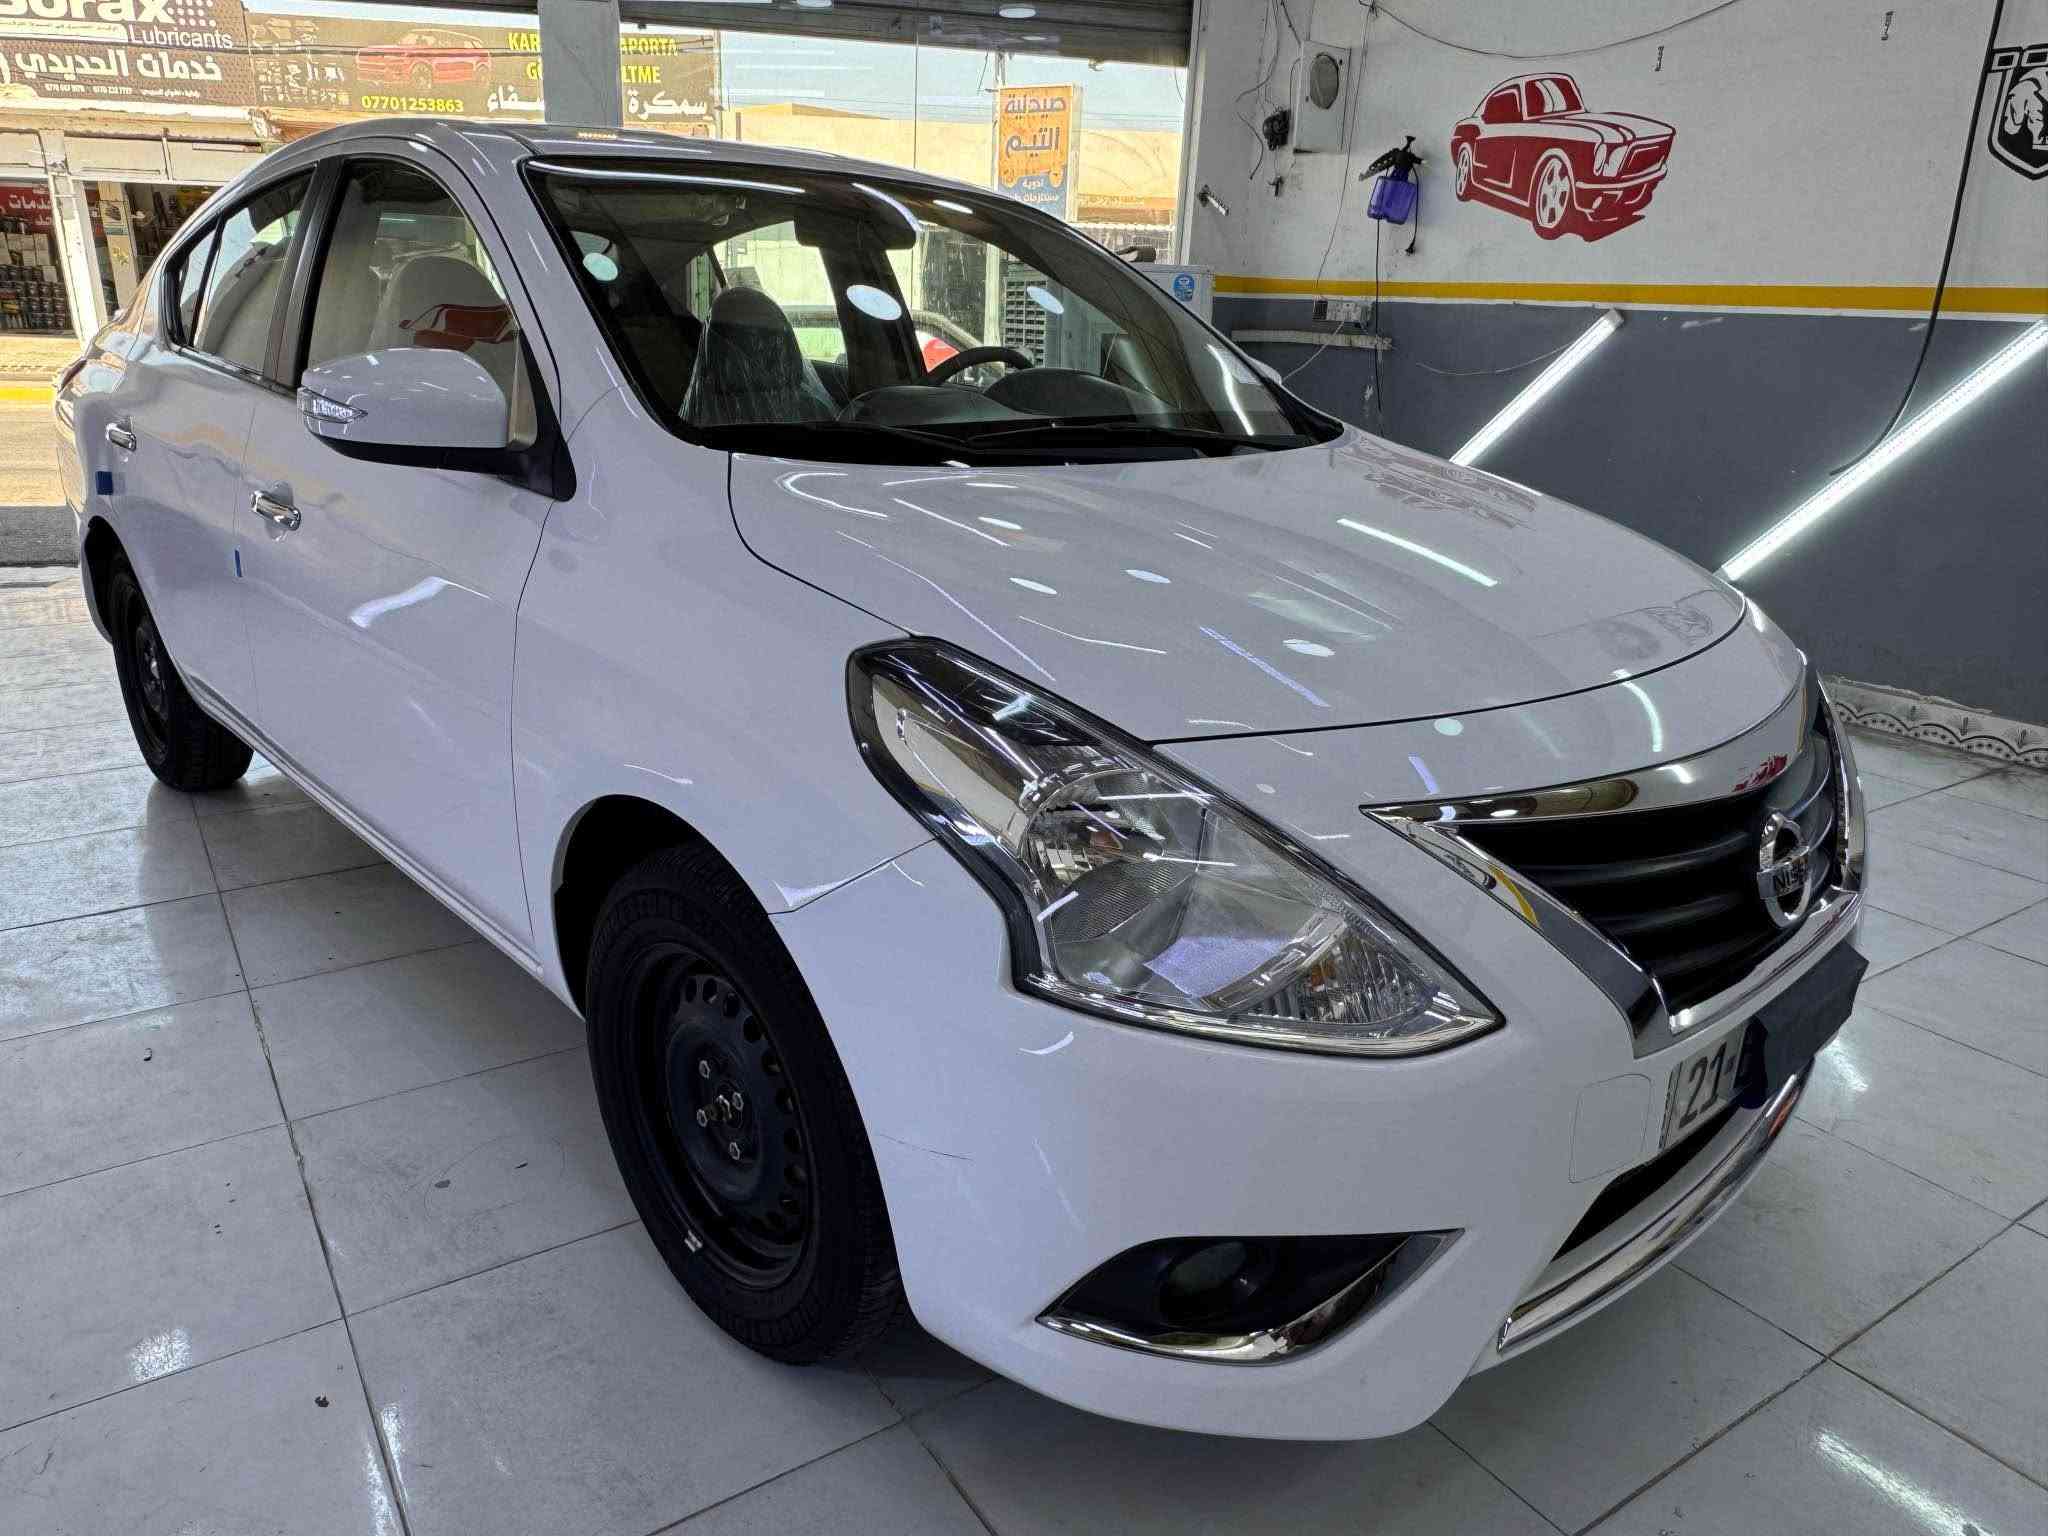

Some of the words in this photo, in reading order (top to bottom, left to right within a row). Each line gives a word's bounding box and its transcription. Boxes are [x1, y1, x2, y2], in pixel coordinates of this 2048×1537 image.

[130, 24, 233, 48] Lubricants
[15, 49, 129, 80] الحديدي
[136, 51, 223, 80] خدمات
[361, 95, 464, 112] 07701253863
[627, 90, 708, 119] سمكرة
[1004, 94, 1067, 120] صيدلية
[1679, 1041, 1728, 1129] 21
